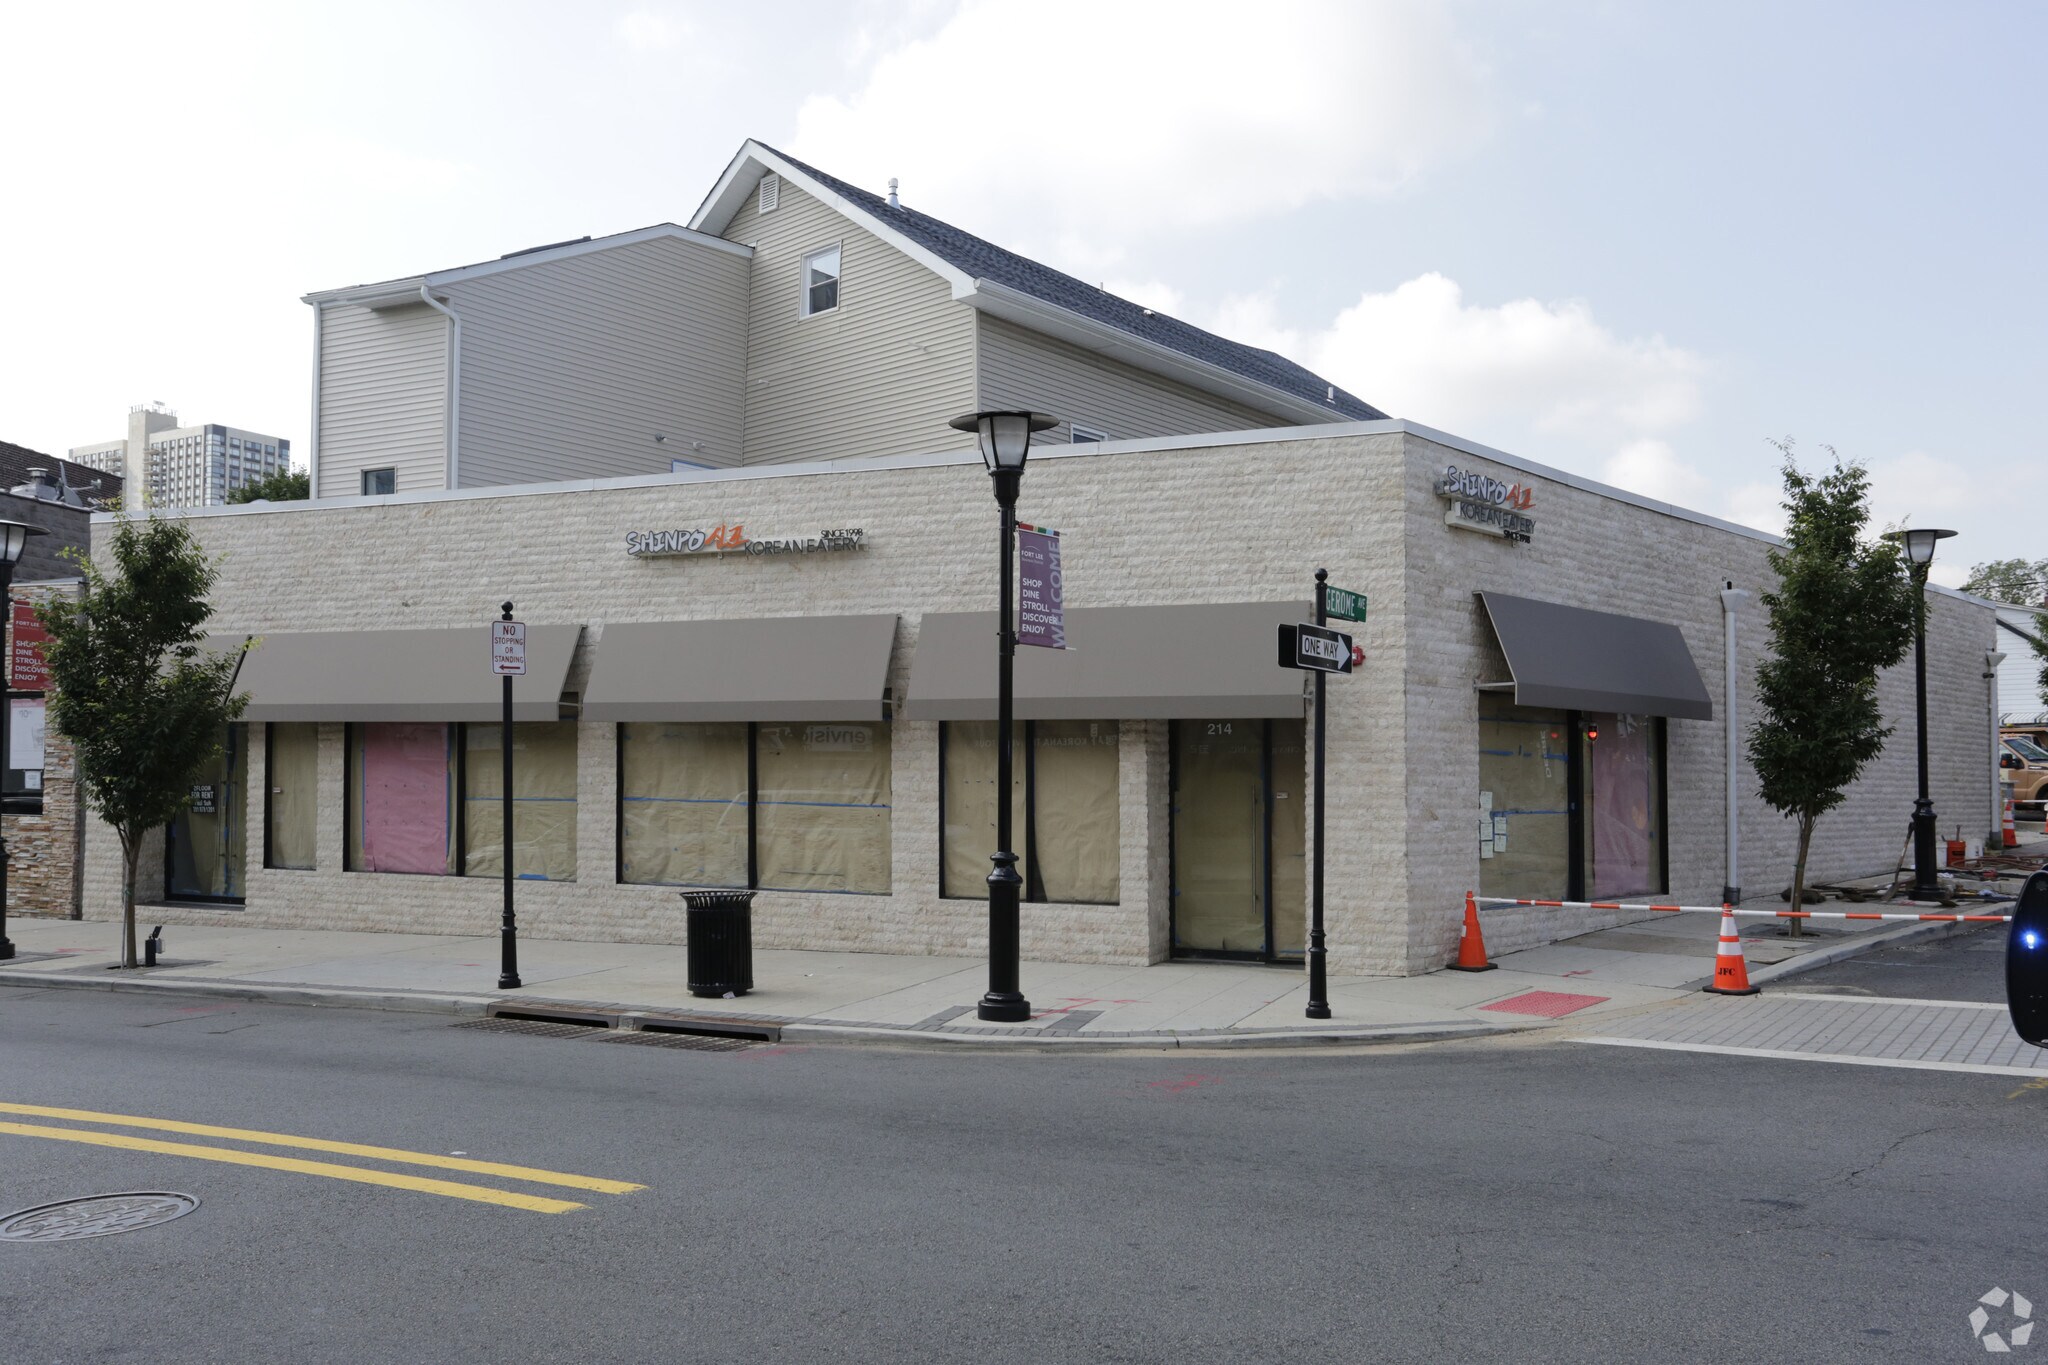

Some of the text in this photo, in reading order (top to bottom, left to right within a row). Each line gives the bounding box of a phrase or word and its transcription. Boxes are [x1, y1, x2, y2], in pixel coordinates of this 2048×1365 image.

[1447, 465, 1507, 505] SHINPO
[1460, 502, 1536, 534] KOREAN EATERY
[821, 528, 863, 538] SINCE 1998
[626, 529, 705, 554] SHINPO
[744, 537, 860, 556] KOREAN EATERY
[1021, 550, 1034, 558] FORT
[1022, 578, 1042, 588] SHOP
[1022, 589, 1040, 599] DINE
[1048, 540, 1065, 648] WELCOME
[1022, 601, 1050, 612] STROLL
[1326, 588, 1366, 617] GEROME AVE
[1022, 612, 1058, 625] DISCOVER
[503, 626, 516, 636] NO
[1022, 624, 1045, 634] ENJOY
[494, 637, 523, 645] STOPPING
[1304, 637, 1339, 659] ONE WAY
[15, 657, 42, 665] STROLL
[1207, 723, 1232, 735] 214
[201, 791, 214, 799] RENT
[1718, 967, 1736, 976] JFC
